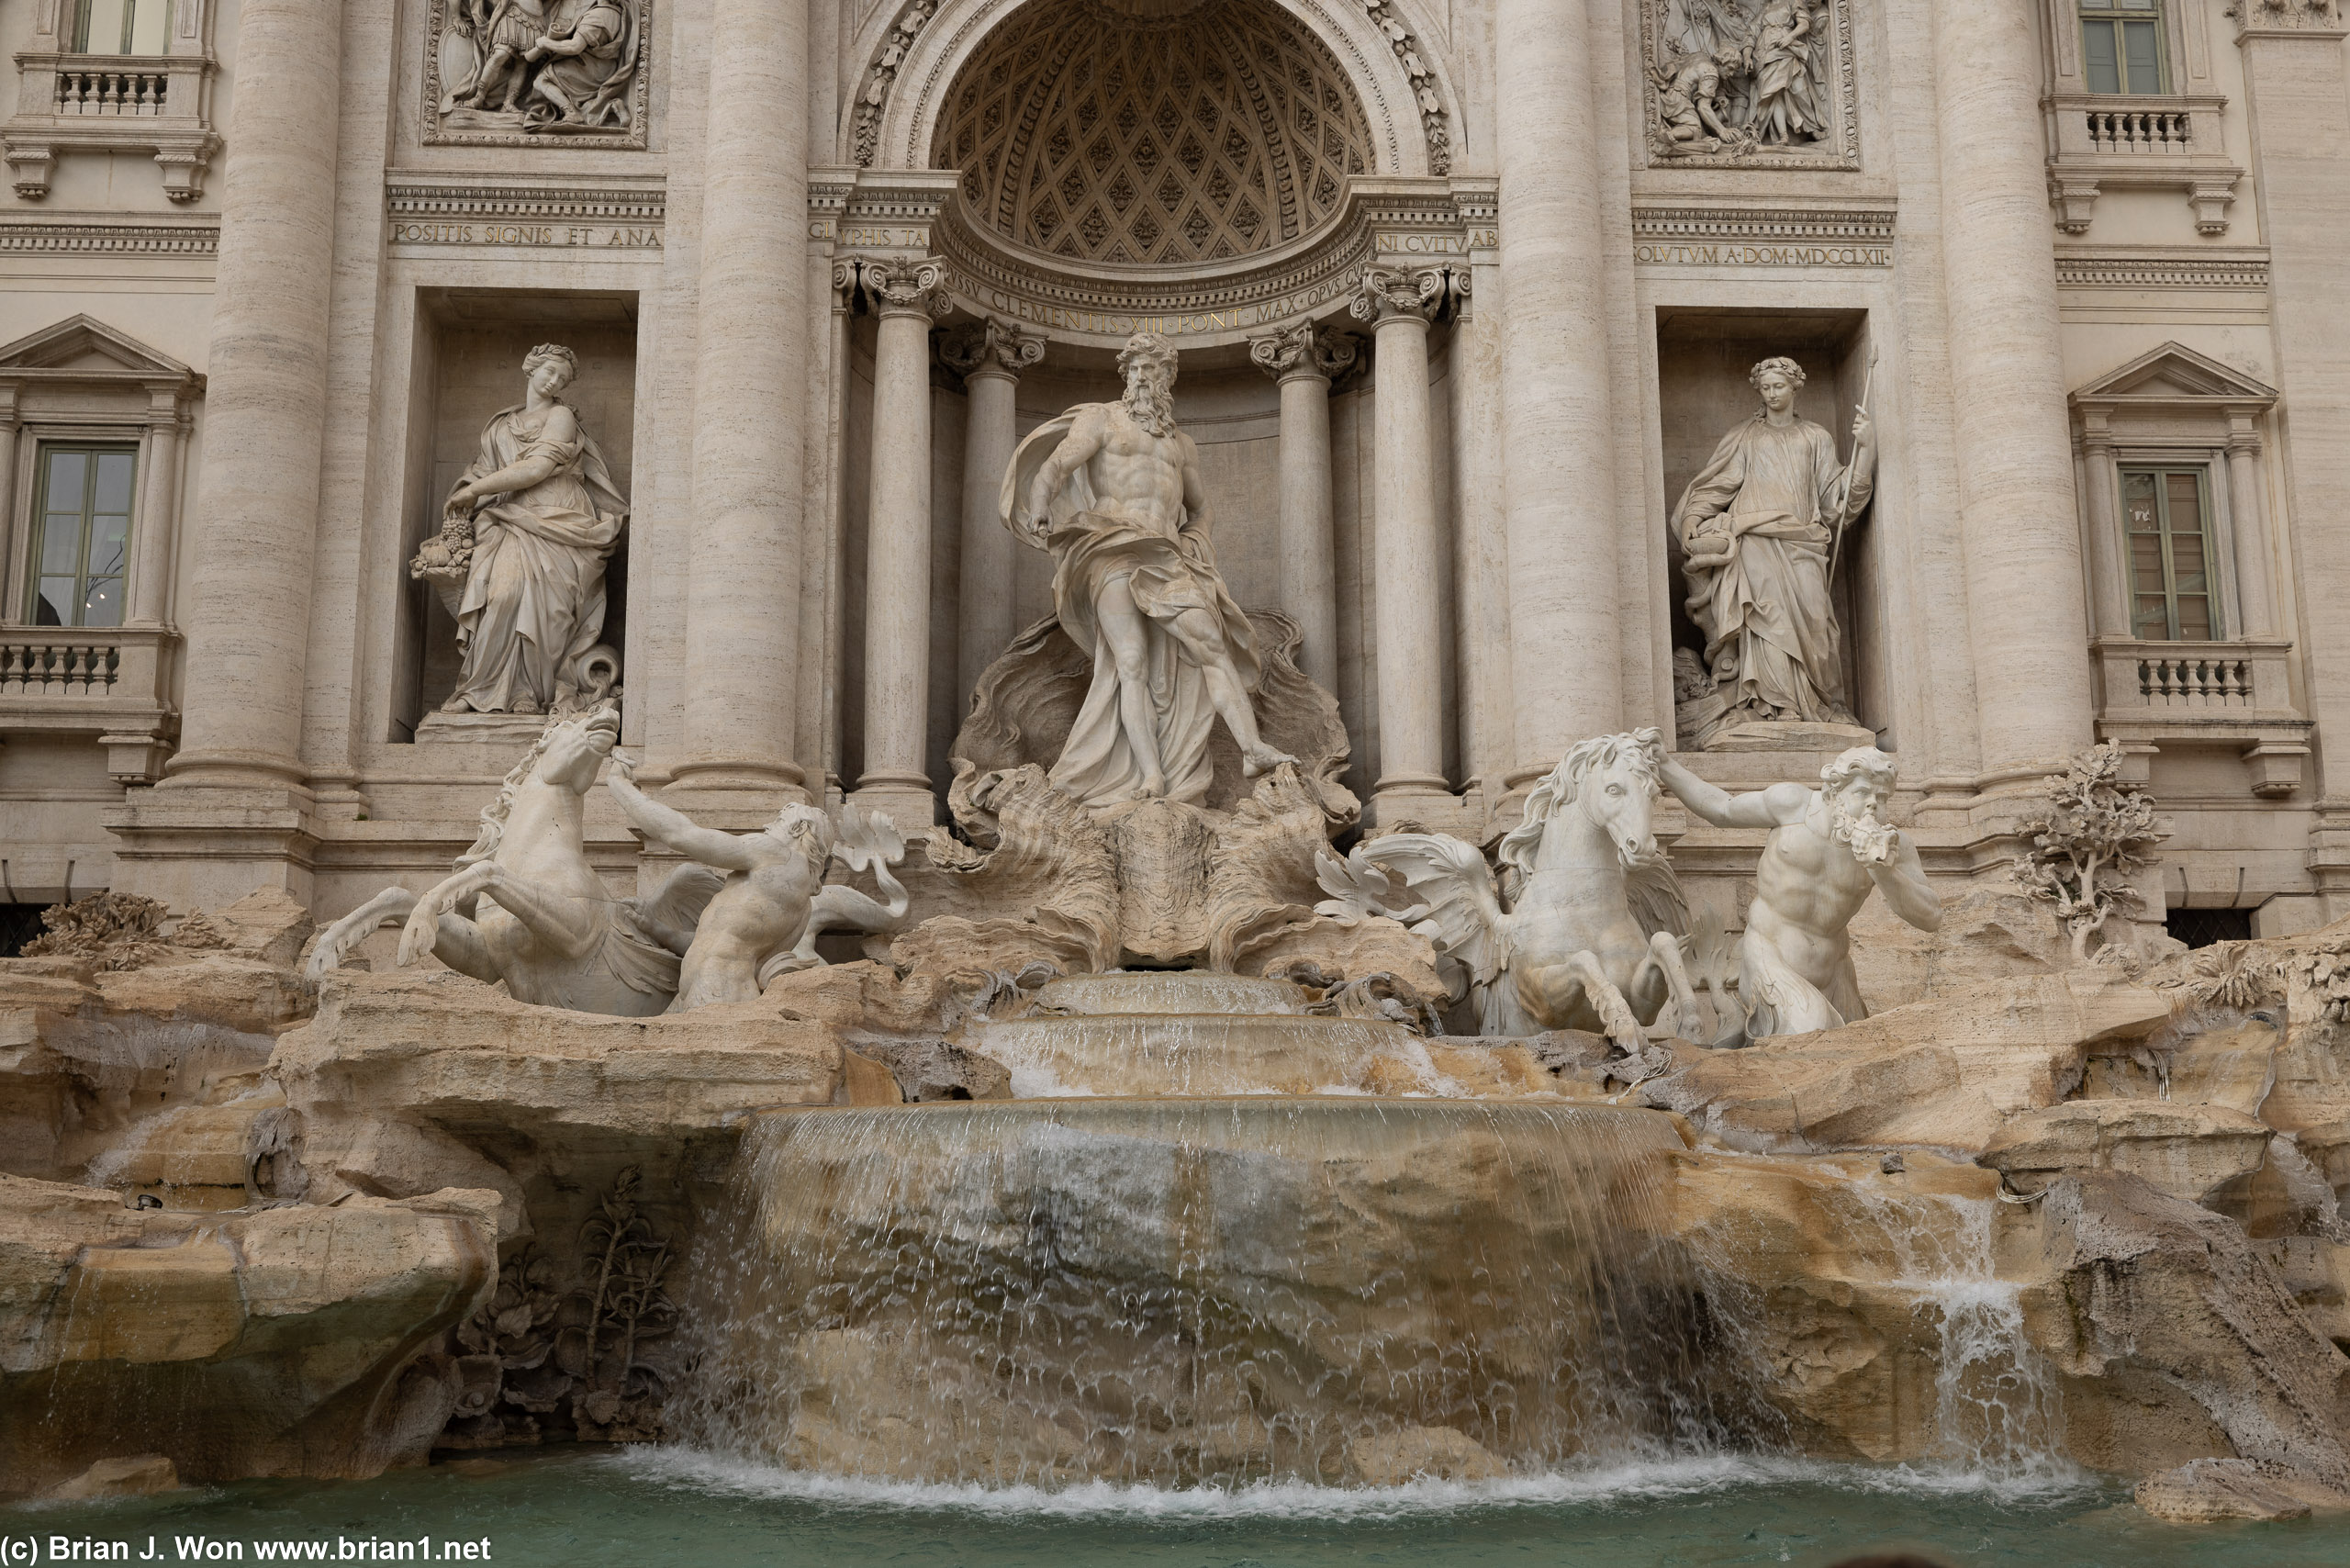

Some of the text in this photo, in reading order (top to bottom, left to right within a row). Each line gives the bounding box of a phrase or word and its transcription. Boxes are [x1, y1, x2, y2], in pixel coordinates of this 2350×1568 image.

[395, 224, 661, 246] POSITIS SIGNIS ET ANA
[901, 230, 926, 246] TA
[1377, 234, 1398, 252] NI
[1470, 230, 1497, 246] AB
